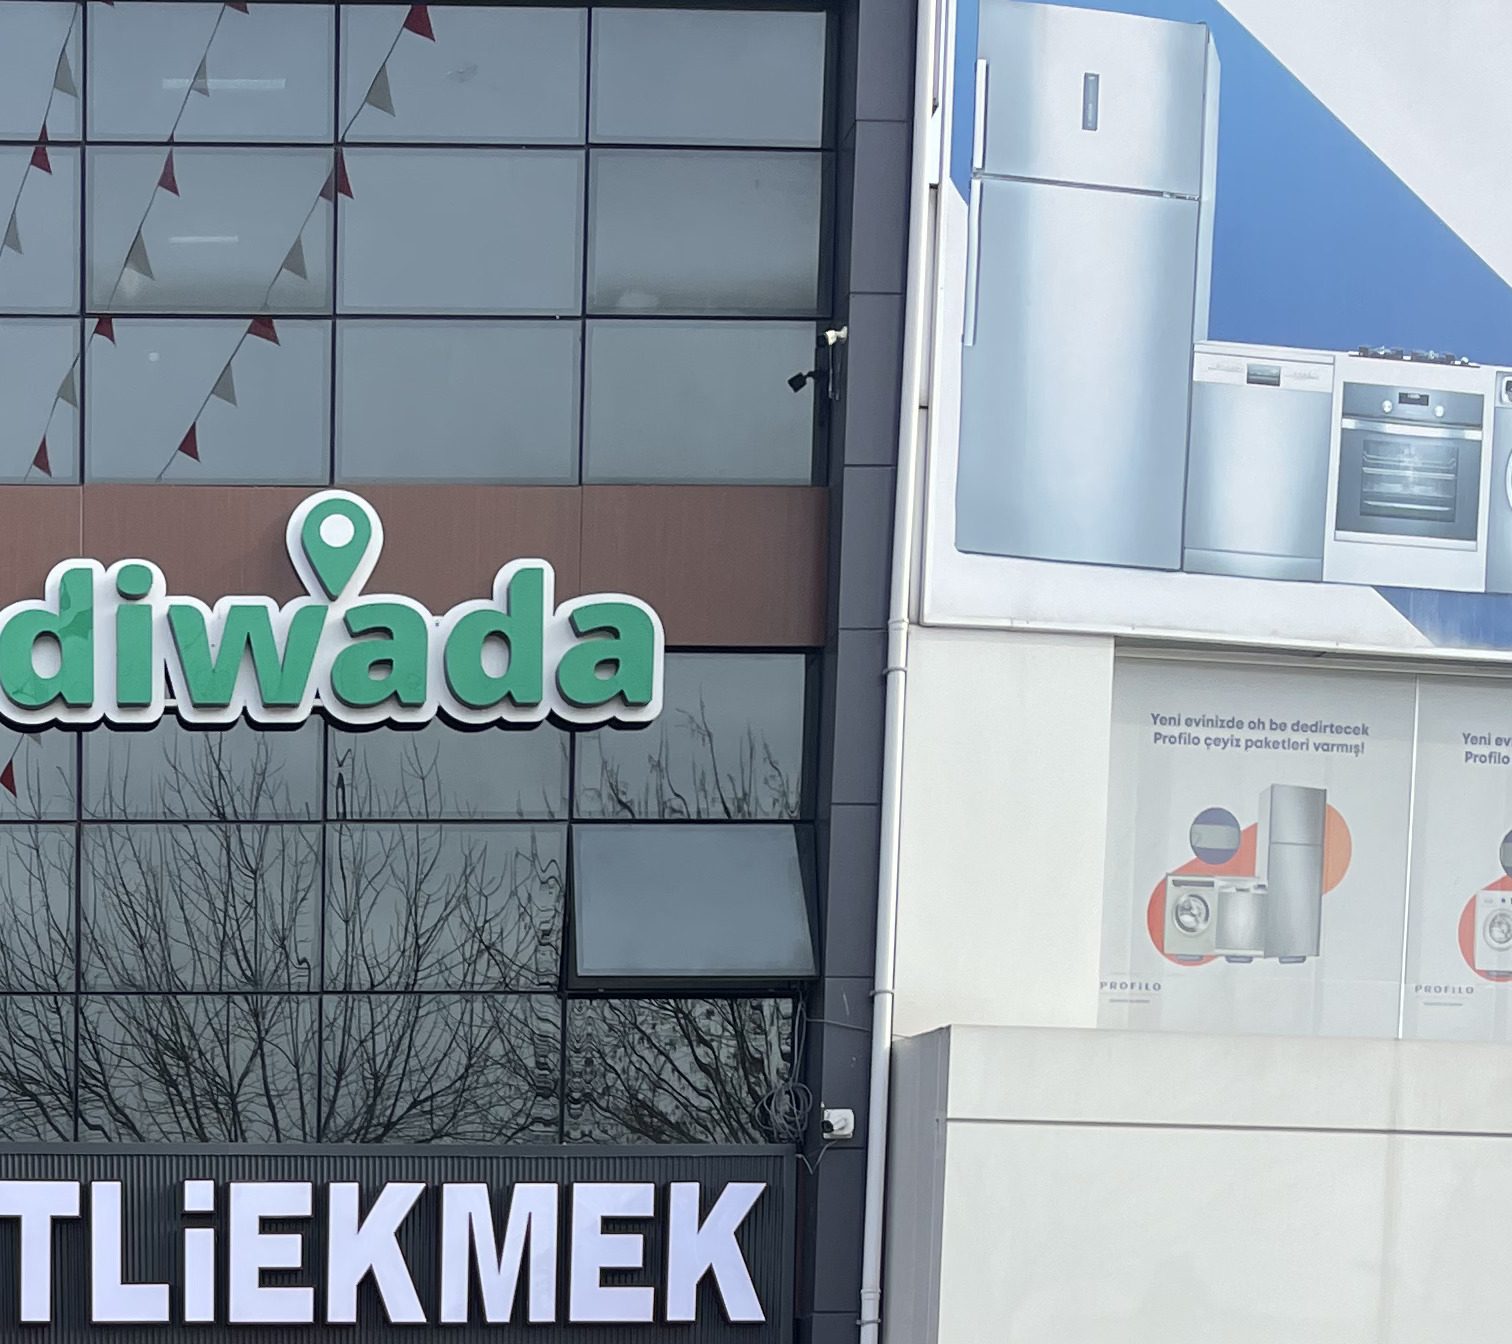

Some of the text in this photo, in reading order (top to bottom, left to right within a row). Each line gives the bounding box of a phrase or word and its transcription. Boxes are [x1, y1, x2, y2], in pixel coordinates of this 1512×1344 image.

[1151, 713, 1369, 736] Yeni evinizde oh be dedirtecek
[1153, 732, 1200, 746] Profilo
[1204, 734, 1241, 750] çeyiz
[1244, 736, 1309, 752] paketleri
[1462, 732, 1491, 746] Yeni
[1464, 750, 1511, 765] Profilo
